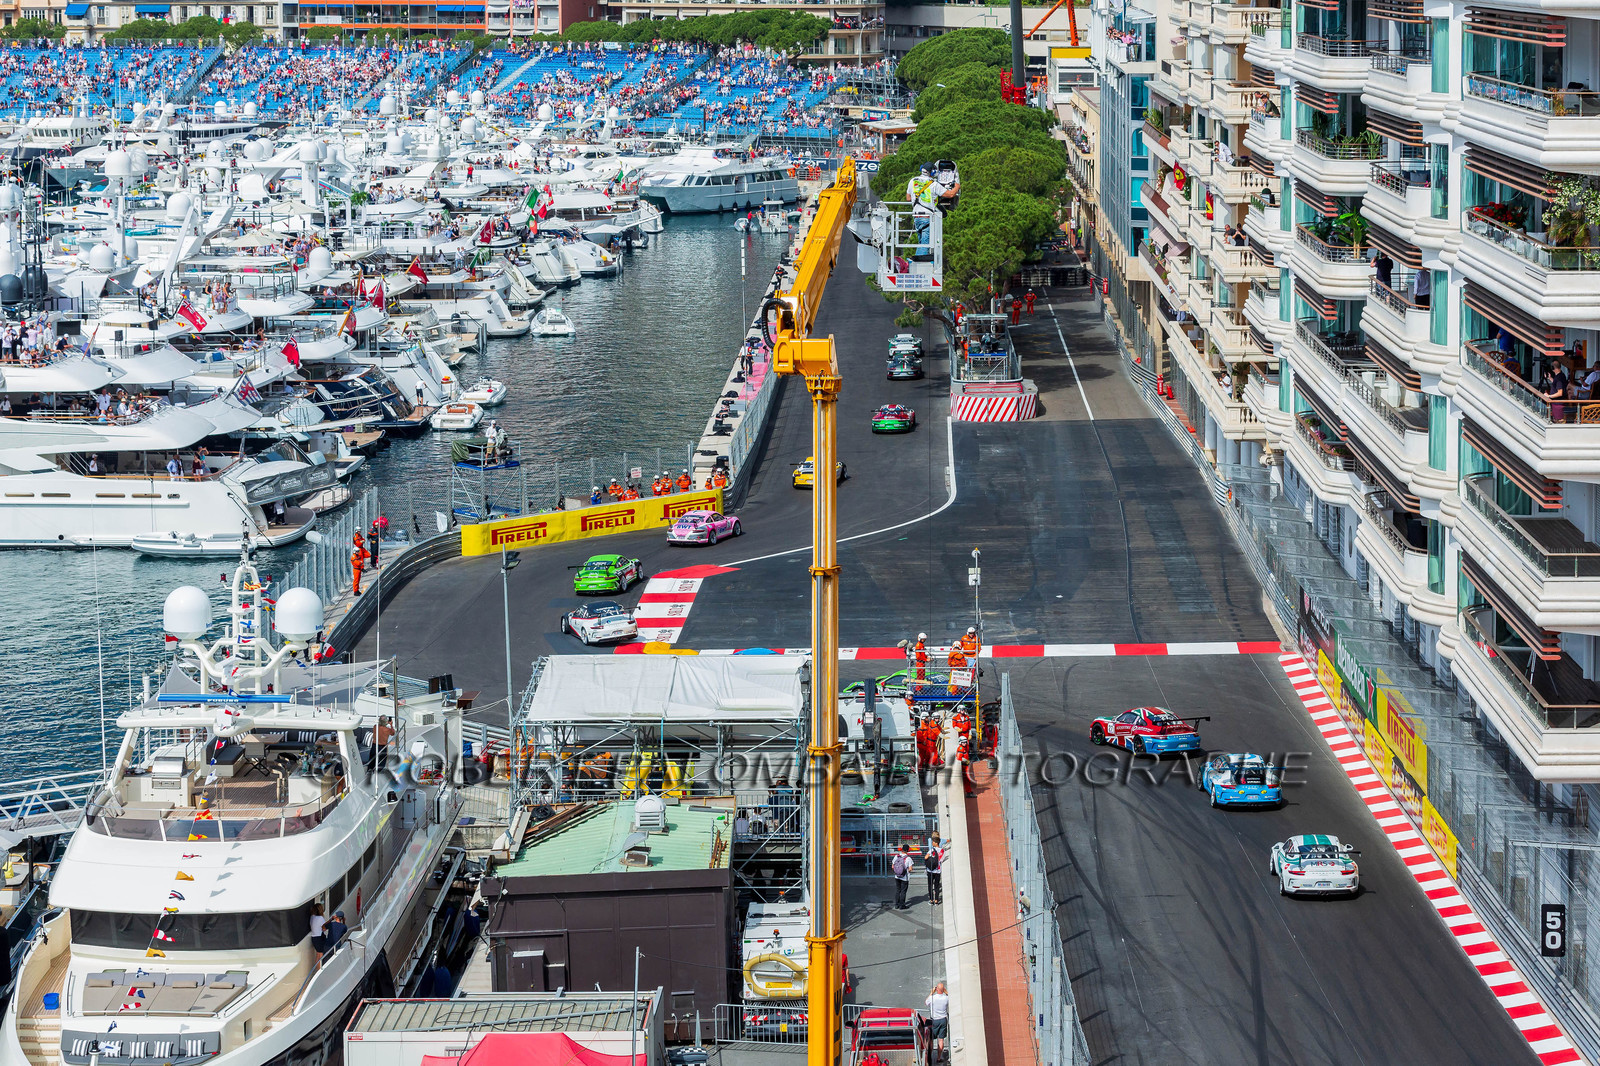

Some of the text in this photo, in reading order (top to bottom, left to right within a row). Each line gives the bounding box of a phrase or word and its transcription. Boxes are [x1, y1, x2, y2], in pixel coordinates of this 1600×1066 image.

[491, 522, 547, 546] PIRELLI
[581, 508, 635, 532] PIRELLI
[1338, 633, 1366, 703] Heineken
[1387, 700, 1416, 768] PIRELLI
[1545, 911, 1562, 949] 50
